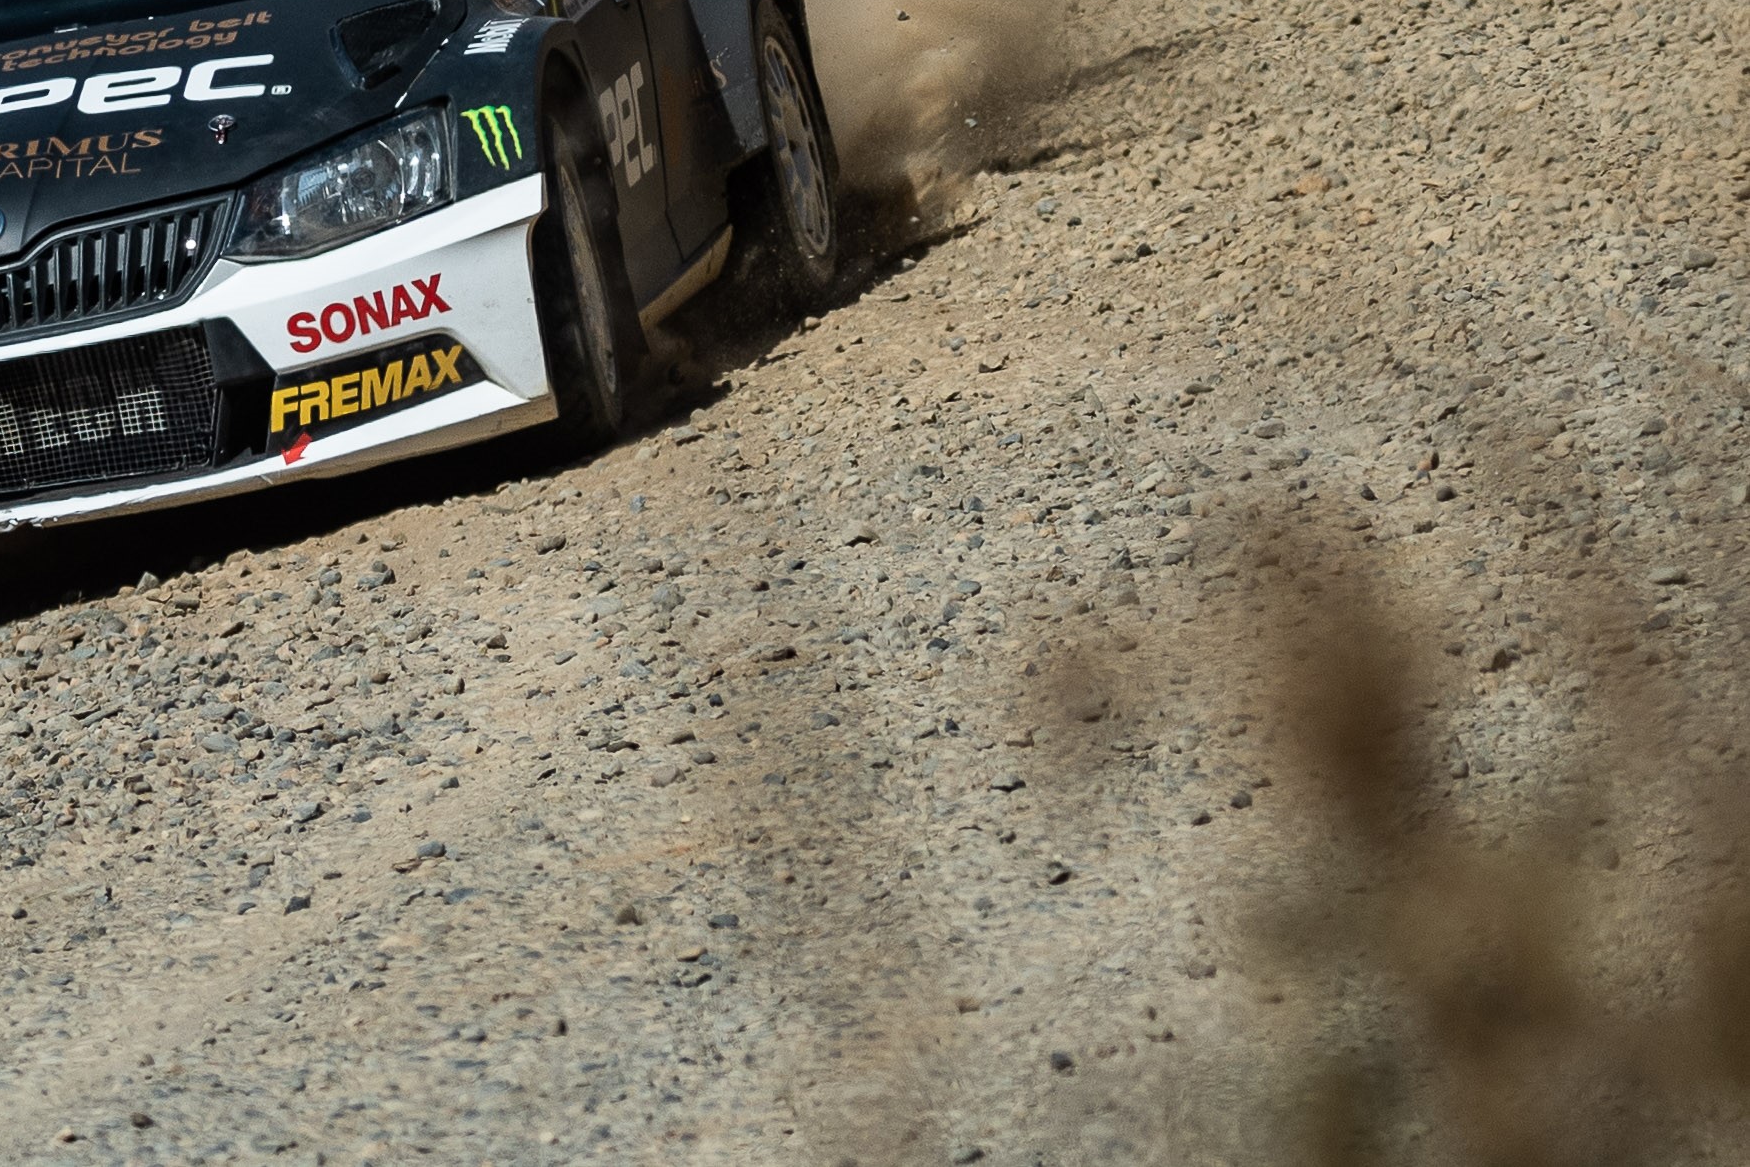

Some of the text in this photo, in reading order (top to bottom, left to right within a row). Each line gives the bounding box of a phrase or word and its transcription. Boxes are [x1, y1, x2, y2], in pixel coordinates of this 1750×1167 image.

[2, 30, 239, 72] technology
[188, 10, 272, 33] belt
[287, 272, 453, 354] SONAX
[270, 344, 464, 434] FREMAX
